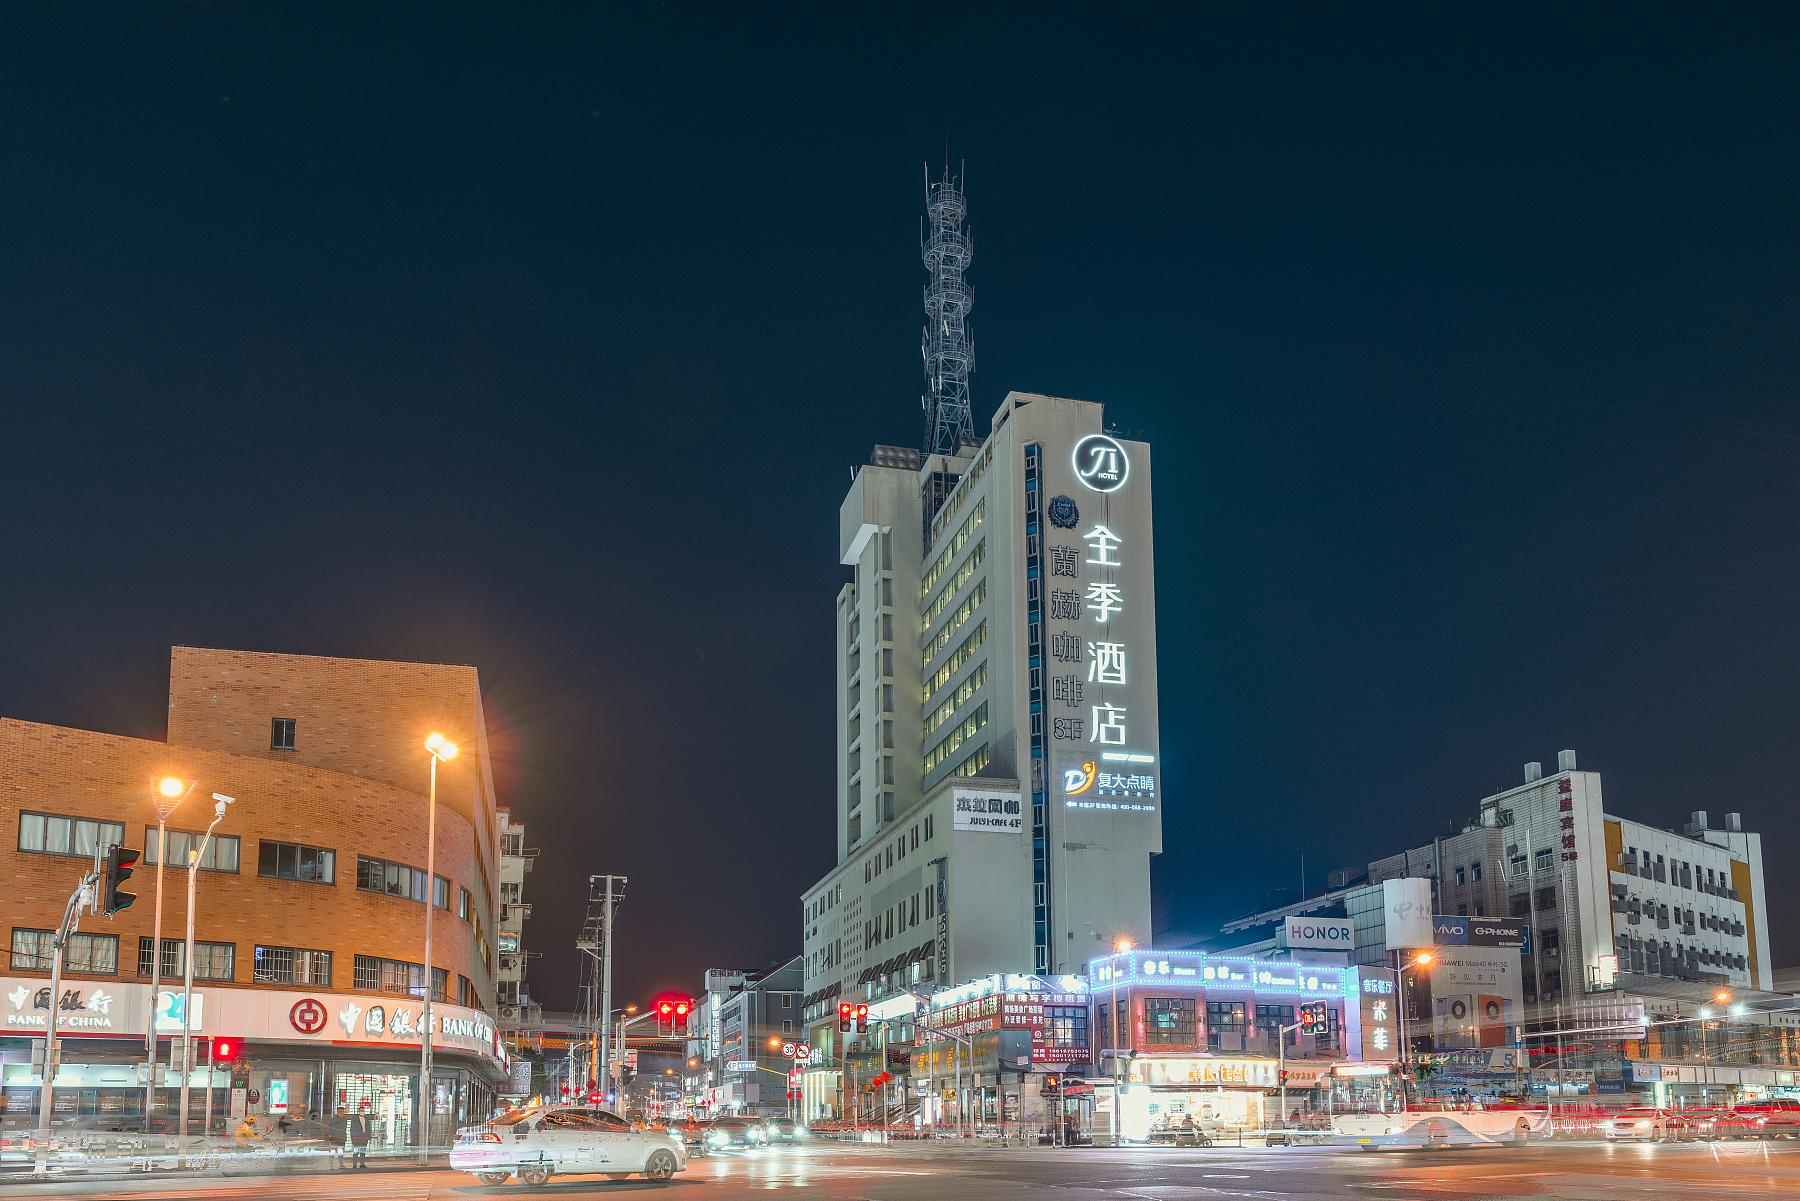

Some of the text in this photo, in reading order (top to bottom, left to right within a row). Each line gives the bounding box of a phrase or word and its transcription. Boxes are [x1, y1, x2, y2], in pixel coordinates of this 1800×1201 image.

[1098, 472, 1118, 480] HOTEL
[1083, 525, 1127, 745] 全季酒店
[1098, 773, 1155, 790] 复大点睛
[1291, 925, 1351, 941] HONOR
[1437, 959, 1464, 967] HUAWEI
[1363, 978, 1393, 994] 音乐餐厅
[8, 985, 114, 1015] 中国银行
[7, 1014, 45, 1026] BANK
[68, 1016, 112, 1028] CHINA
[339, 1002, 437, 1036] 中国银行
[441, 1017, 473, 1037] BANK
[785, 1046, 794, 1054] 30
